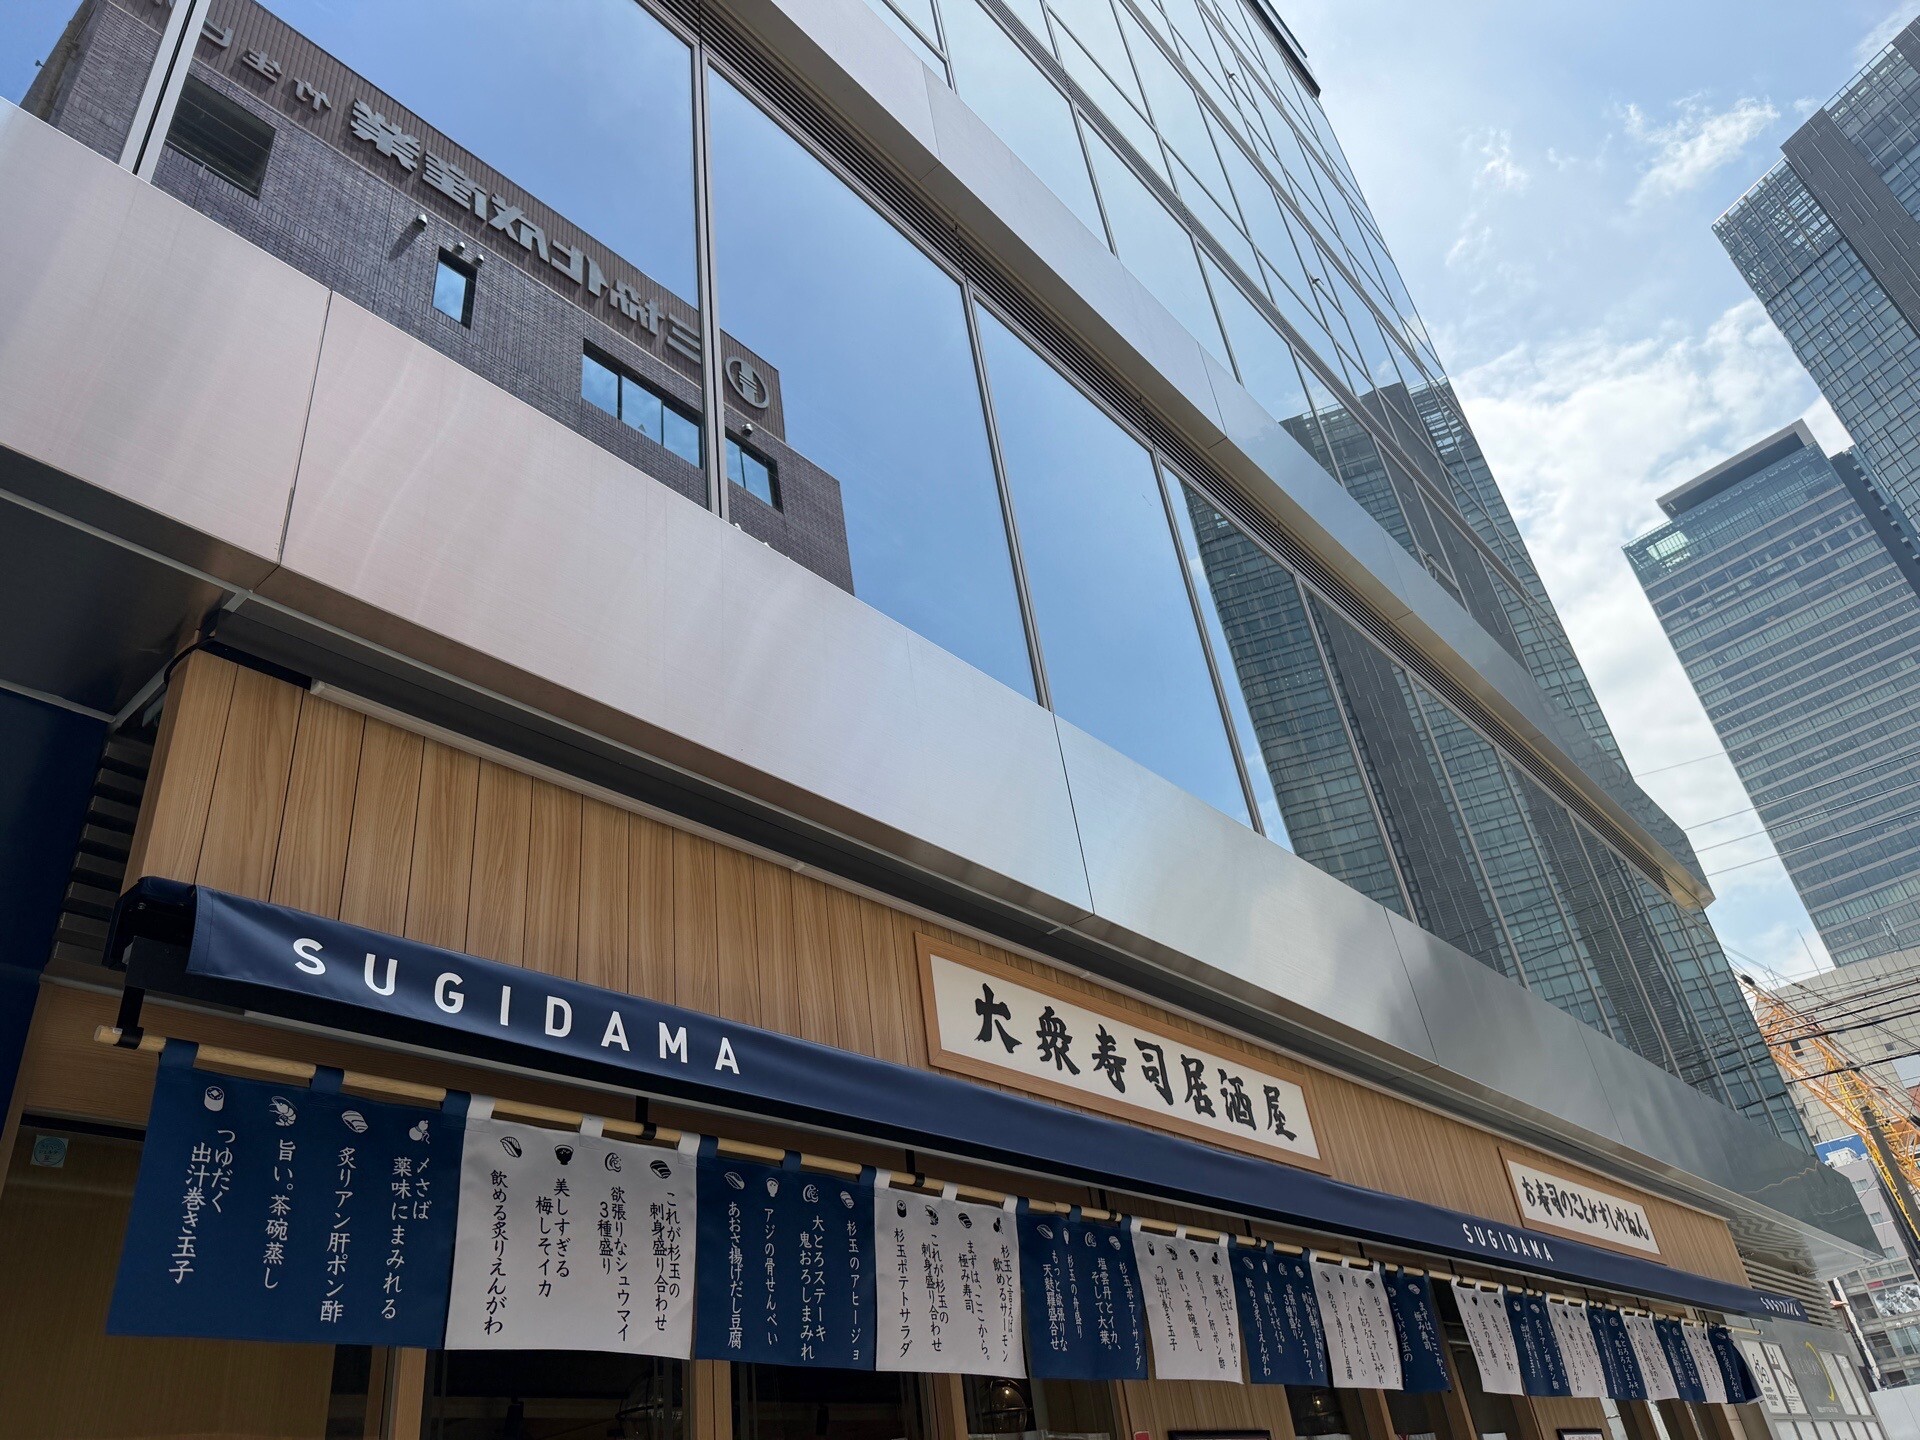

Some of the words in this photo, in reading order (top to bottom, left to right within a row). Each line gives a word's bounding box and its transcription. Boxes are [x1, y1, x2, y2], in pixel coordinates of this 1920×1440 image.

[293, 937, 740, 1075] SUGIDAMA
[974, 983, 1298, 1141] 大衆寿司居酒屋
[168, 1141, 212, 1285] 出汁巻き玉子
[210, 1129, 237, 1214] つゆだく
[263, 1138, 297, 1290] 旨い。茶碗蒸し
[320, 1146, 357, 1324] 炙りアン肝ポン酢
[553, 1178, 571, 1279] 美しすぎる
[1522, 1176, 1650, 1241] お寿司のことがすしやねん
[381, 1156, 413, 1320] 薬味にまみれる
[484, 1169, 509, 1336] 飲める炙りえんがわ
[535, 1195, 555, 1297] 梅しそイカ
[597, 1201, 614, 1276] 3種盛り
[610, 1186, 633, 1342] 欲張りなシュウマイ
[649, 1202, 669, 1332] 刺身盛り合わせ
[665, 1191, 682, 1299] これが杉玉の
[727, 1201, 744, 1350] あおさ揚げだし豆腐
[764, 1207, 779, 1347] アジの骨せんべい
[798, 1231, 816, 1361] 鬼おろしまみれ
[811, 1215, 827, 1344] 大とろステーキ
[846, 1219, 861, 1361] 杉玉のアヒージョ
[893, 1227, 913, 1358] 杉玉ポテトサラダ
[921, 1241, 943, 1353] 刺身盛り合わせ
[930, 1233, 950, 1325] これが杉玉の
[958, 1252, 975, 1314] 極み寿司
[1462, 1222, 1554, 1262] SUGIDAMA
